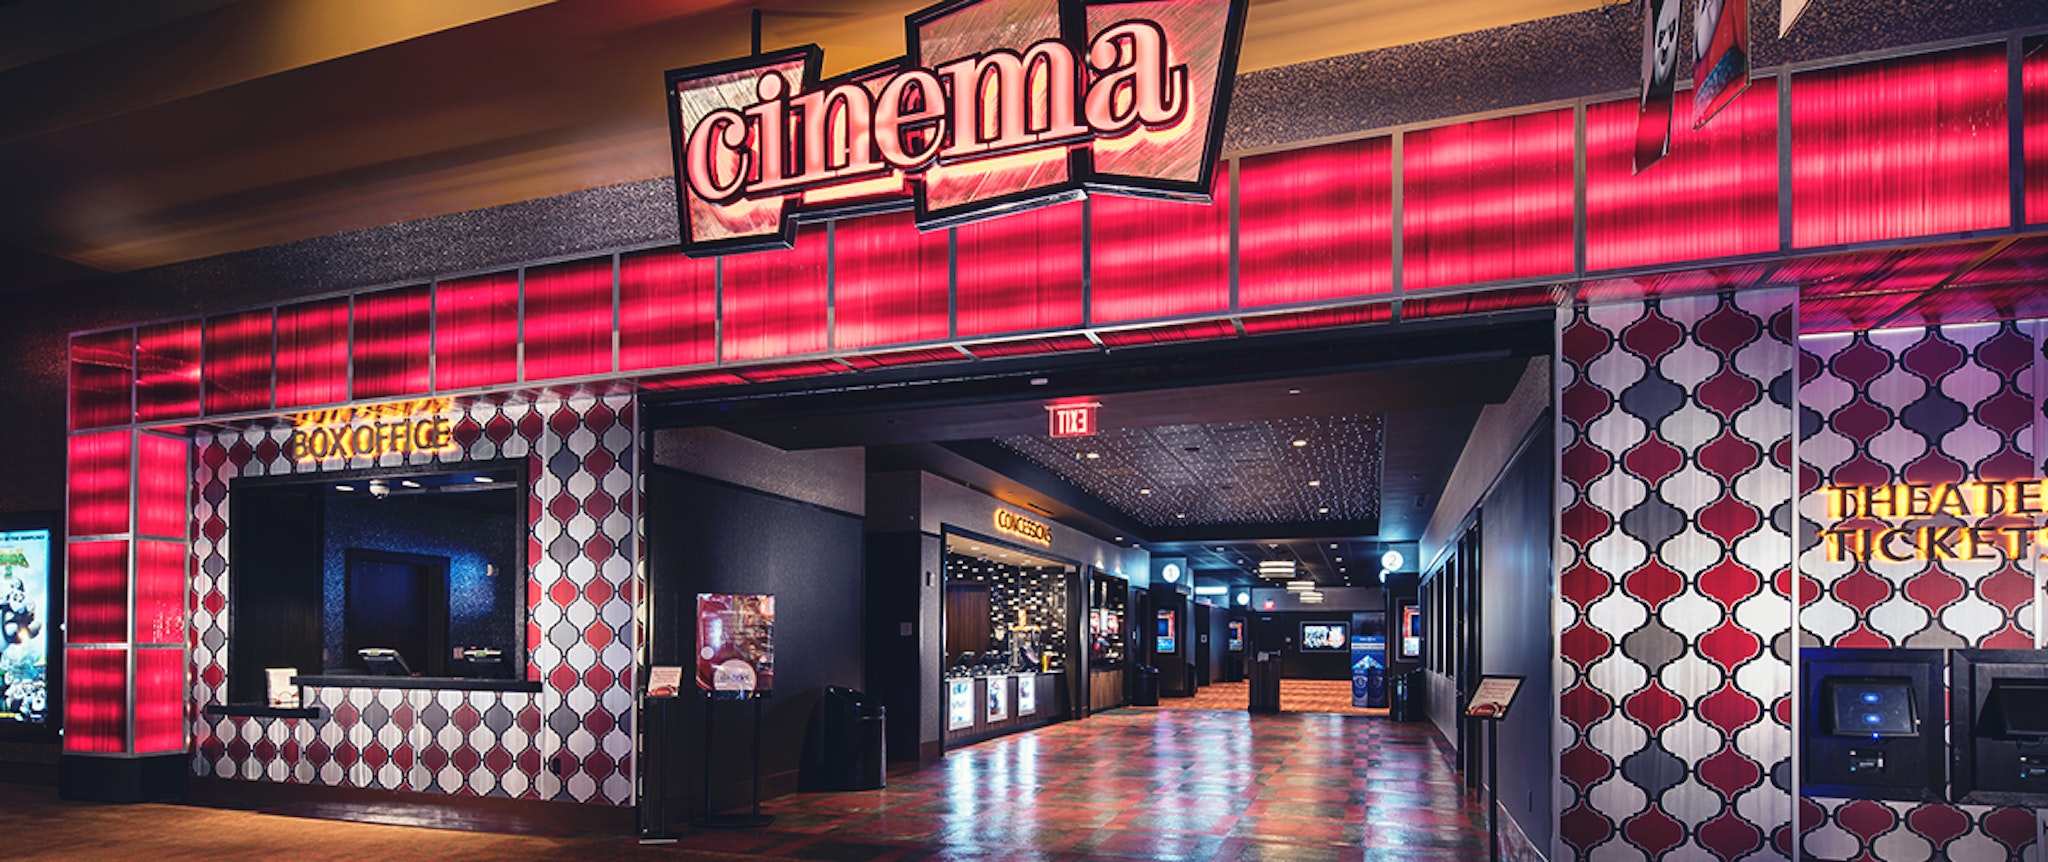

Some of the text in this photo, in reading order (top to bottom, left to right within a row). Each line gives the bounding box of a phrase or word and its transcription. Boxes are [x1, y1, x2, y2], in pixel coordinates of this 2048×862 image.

[685, 19, 1188, 203] cinema
[292, 415, 450, 460] BOX OFFICE
[1828, 480, 2048, 518] THEATE
[998, 510, 1054, 543] CONCESSIONS
[1826, 524, 2048, 562] TICKET
